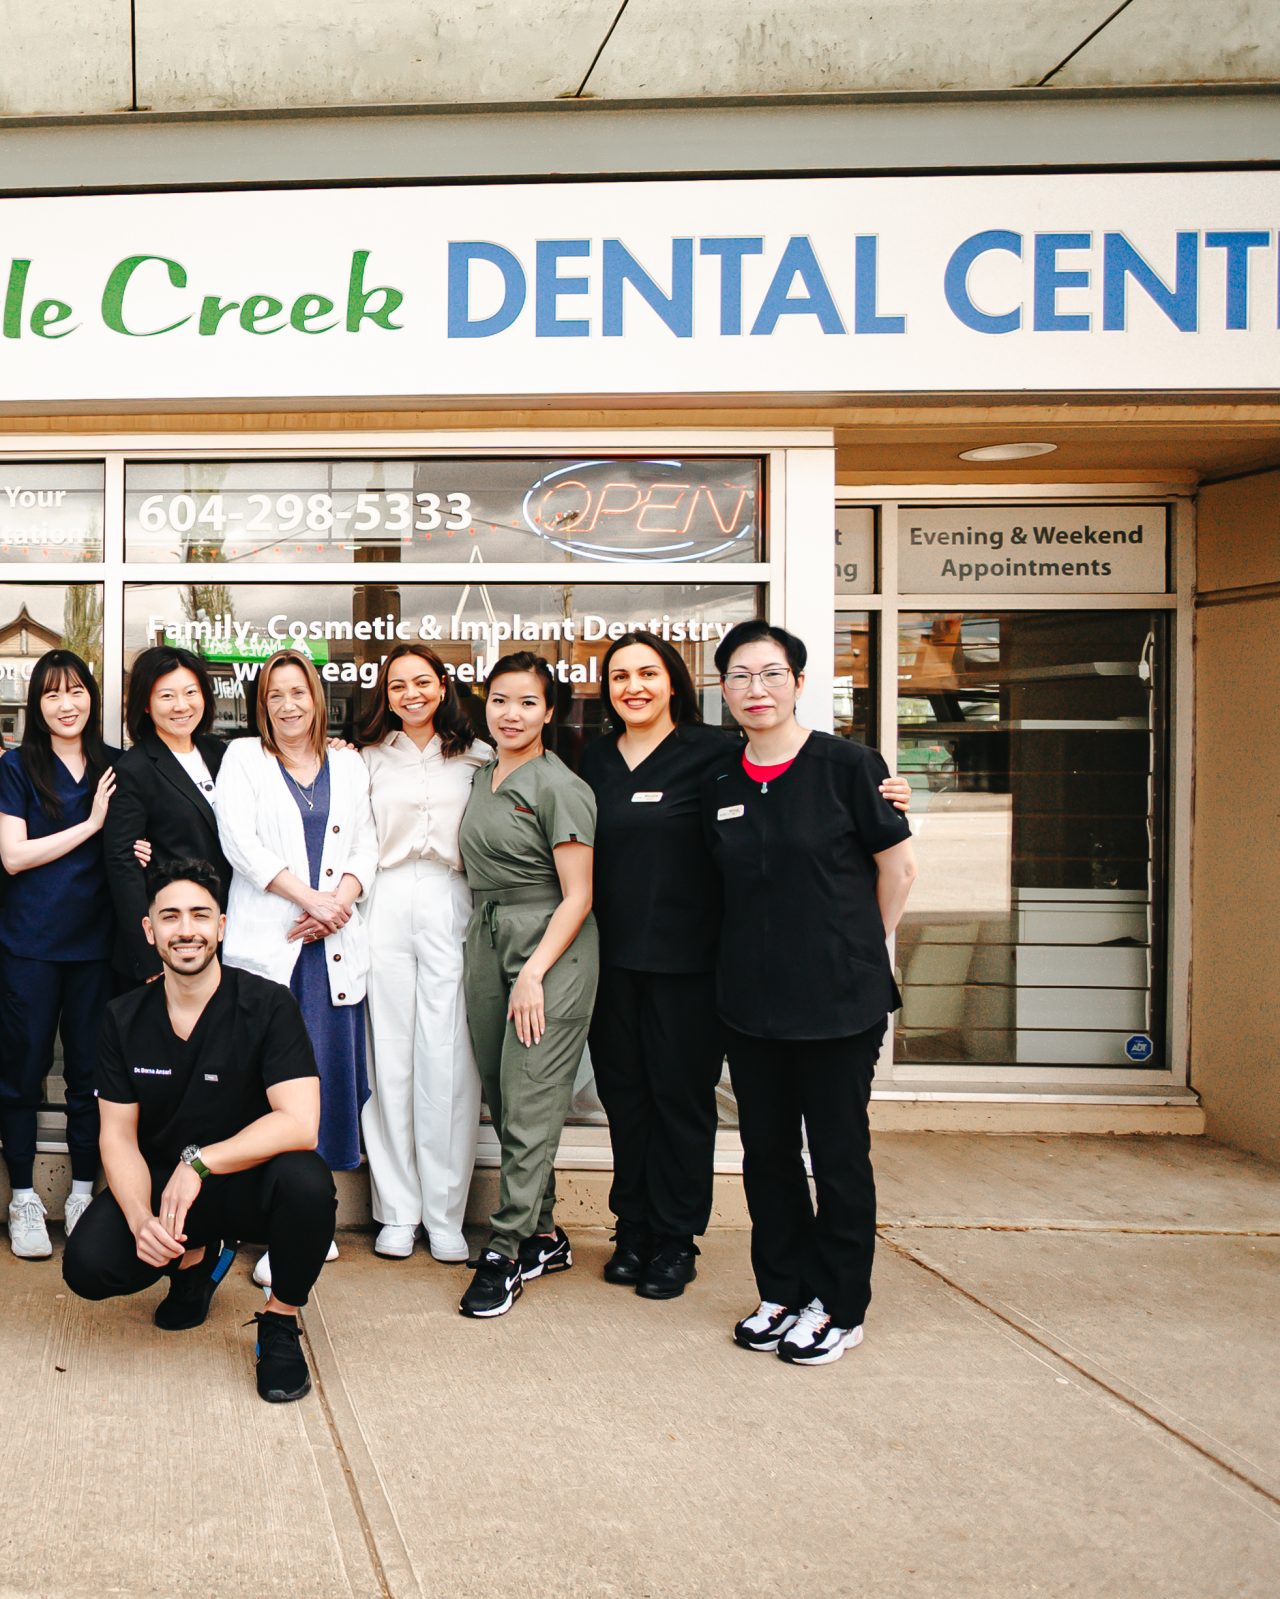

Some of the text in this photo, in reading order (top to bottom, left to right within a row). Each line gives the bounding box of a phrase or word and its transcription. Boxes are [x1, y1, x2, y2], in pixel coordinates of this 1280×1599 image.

[100, 250, 404, 337] Creek
[446, 233, 907, 340] DENTAL
[944, 228, 1280, 335] CENT
[4, 485, 67, 509] Your
[138, 493, 473, 533] 604-298-5333
[542, 480, 752, 535] OPEN
[910, 525, 1144, 550] Evening & Weekend
[941, 558, 1112, 580] Appointments
[148, 613, 259, 649] Family,
[267, 613, 411, 641] Cosmetic
[419, 614, 442, 641] &
[451, 613, 576, 651] Implant
